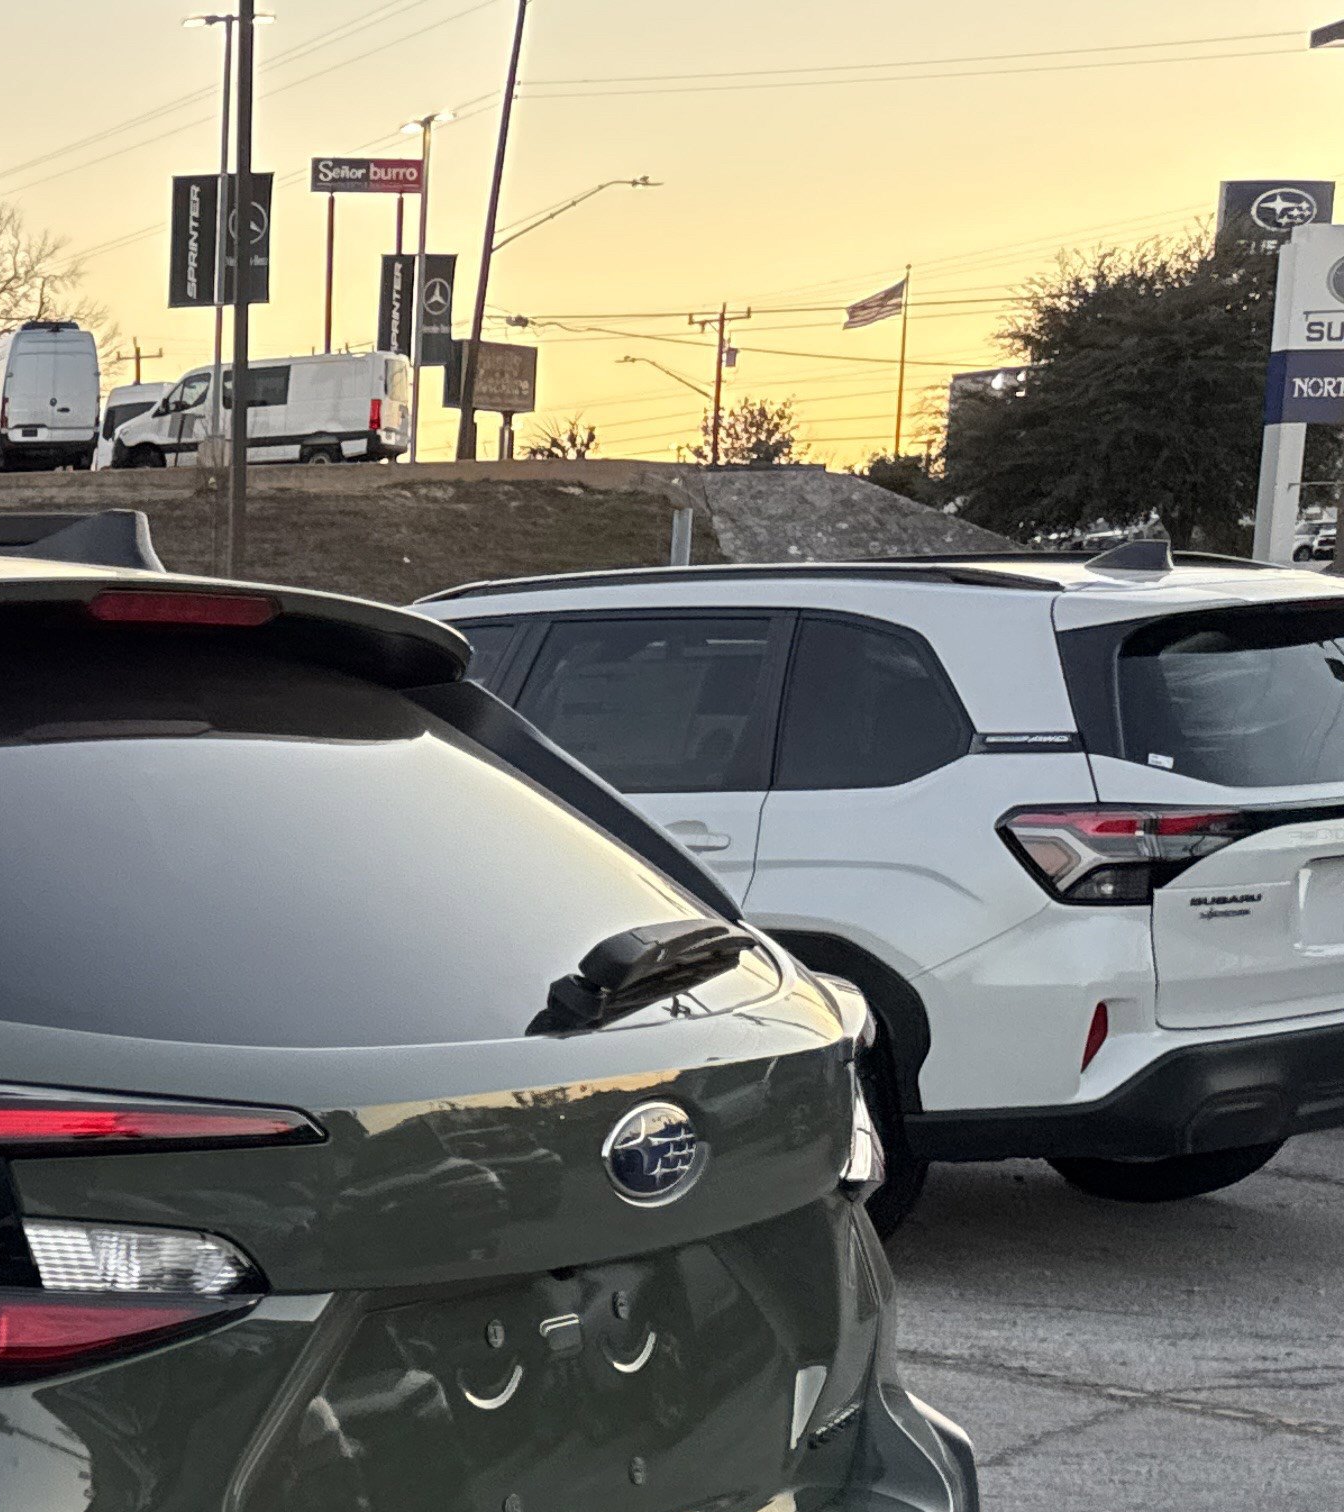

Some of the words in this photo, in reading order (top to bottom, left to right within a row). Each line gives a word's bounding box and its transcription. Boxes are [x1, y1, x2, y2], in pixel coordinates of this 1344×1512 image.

[318, 160, 366, 181] Señor
[369, 162, 418, 181] burro
[187, 184, 201, 299] SPRINTER
[390, 262, 403, 352] PRINTER
[1306, 321, 1344, 341] SU
